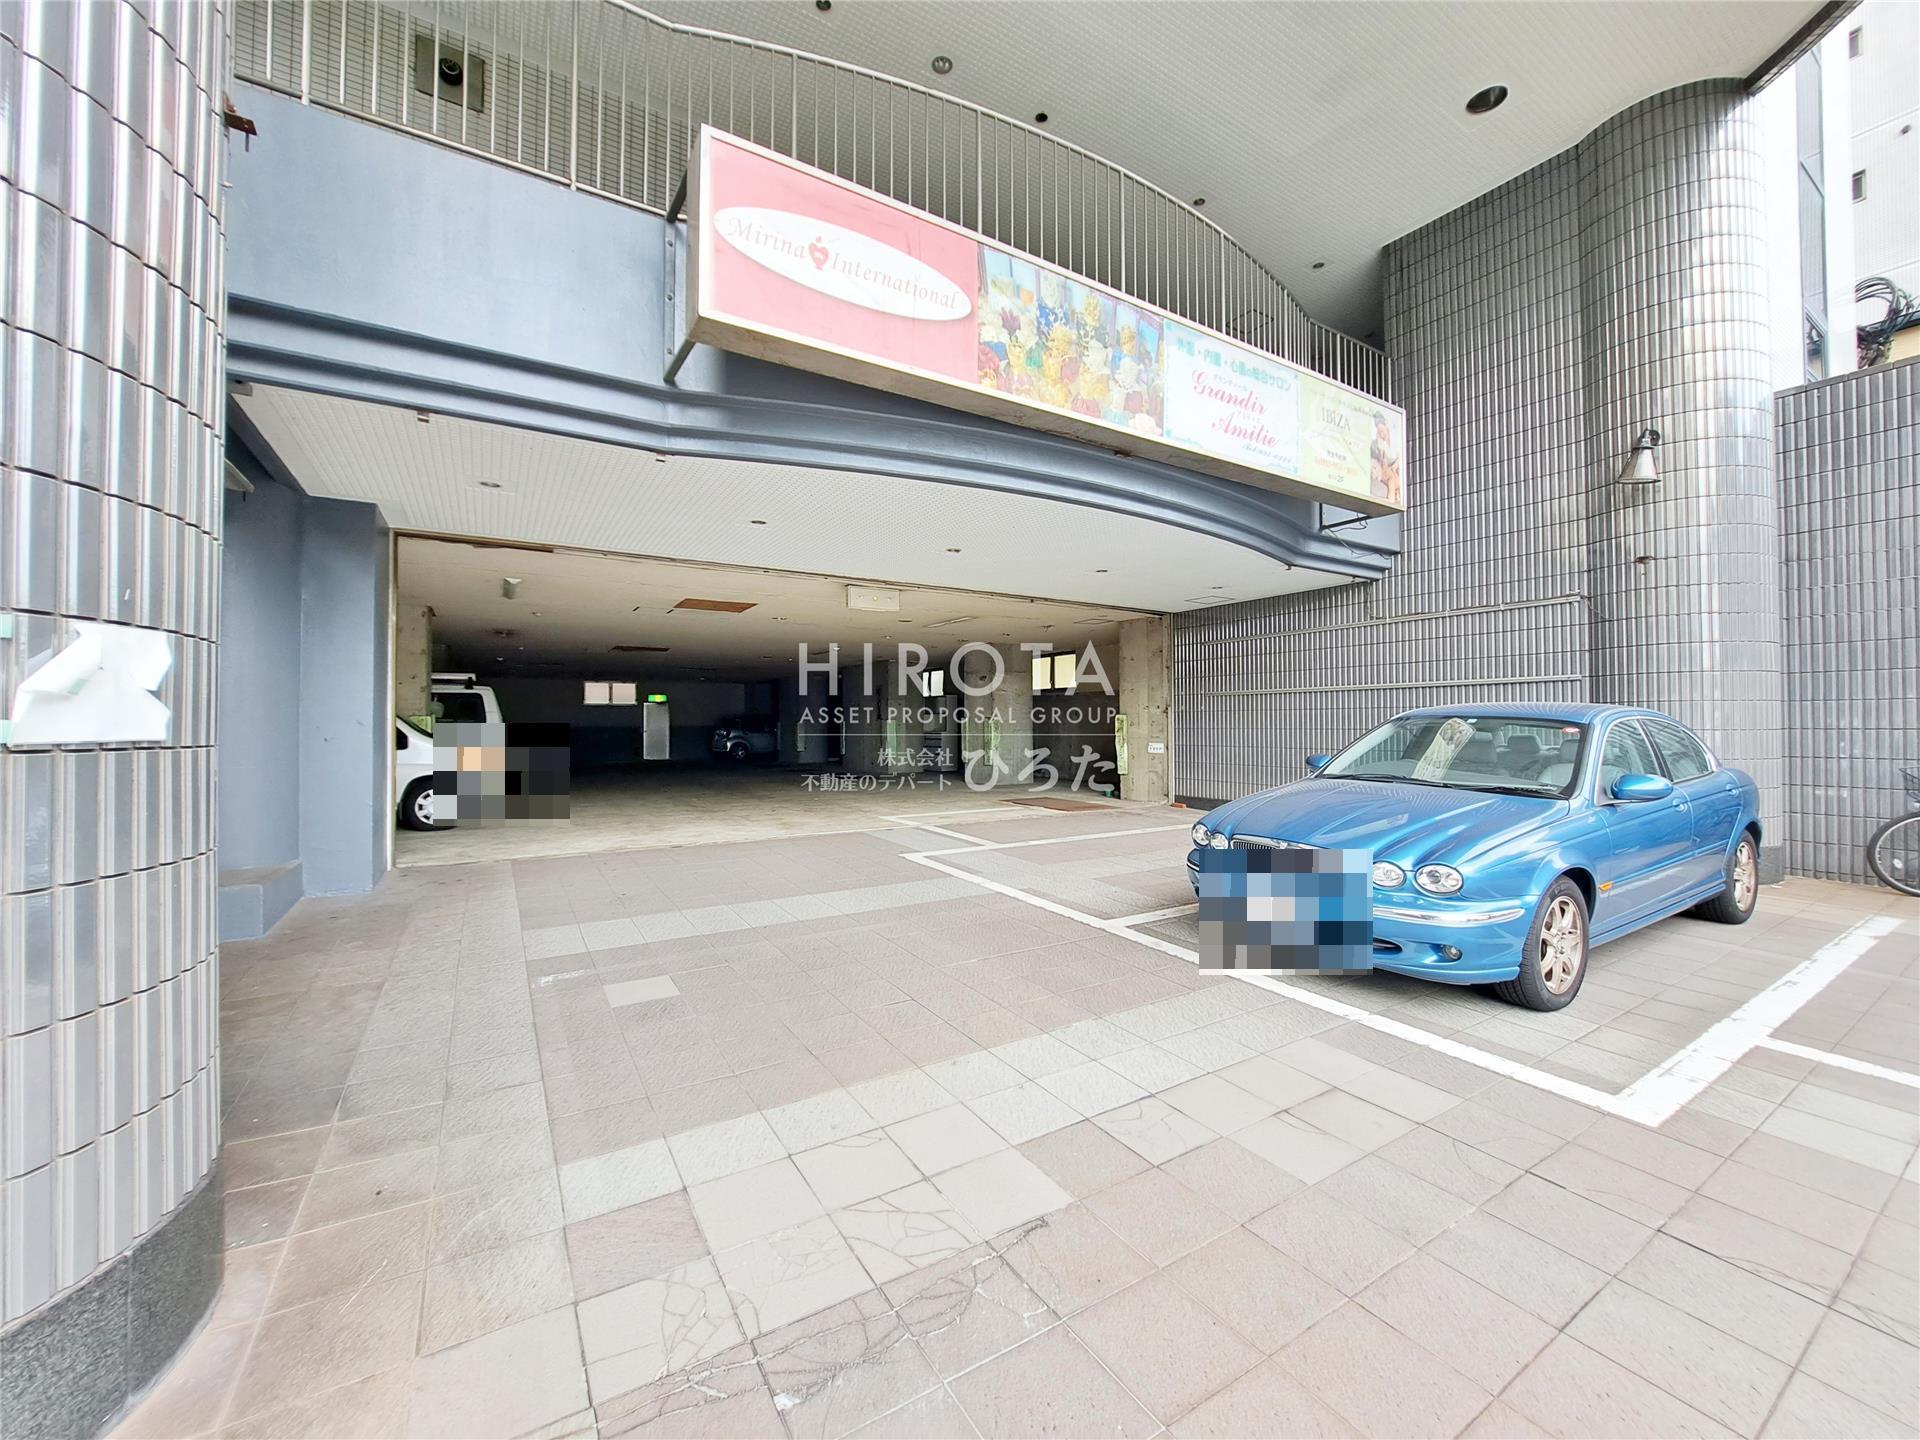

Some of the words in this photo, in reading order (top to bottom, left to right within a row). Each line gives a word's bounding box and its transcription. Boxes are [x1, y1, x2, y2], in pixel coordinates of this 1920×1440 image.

[728, 217, 805, 259] Mirina
[831, 252, 959, 310] International
[1192, 369, 1267, 415] Grandir
